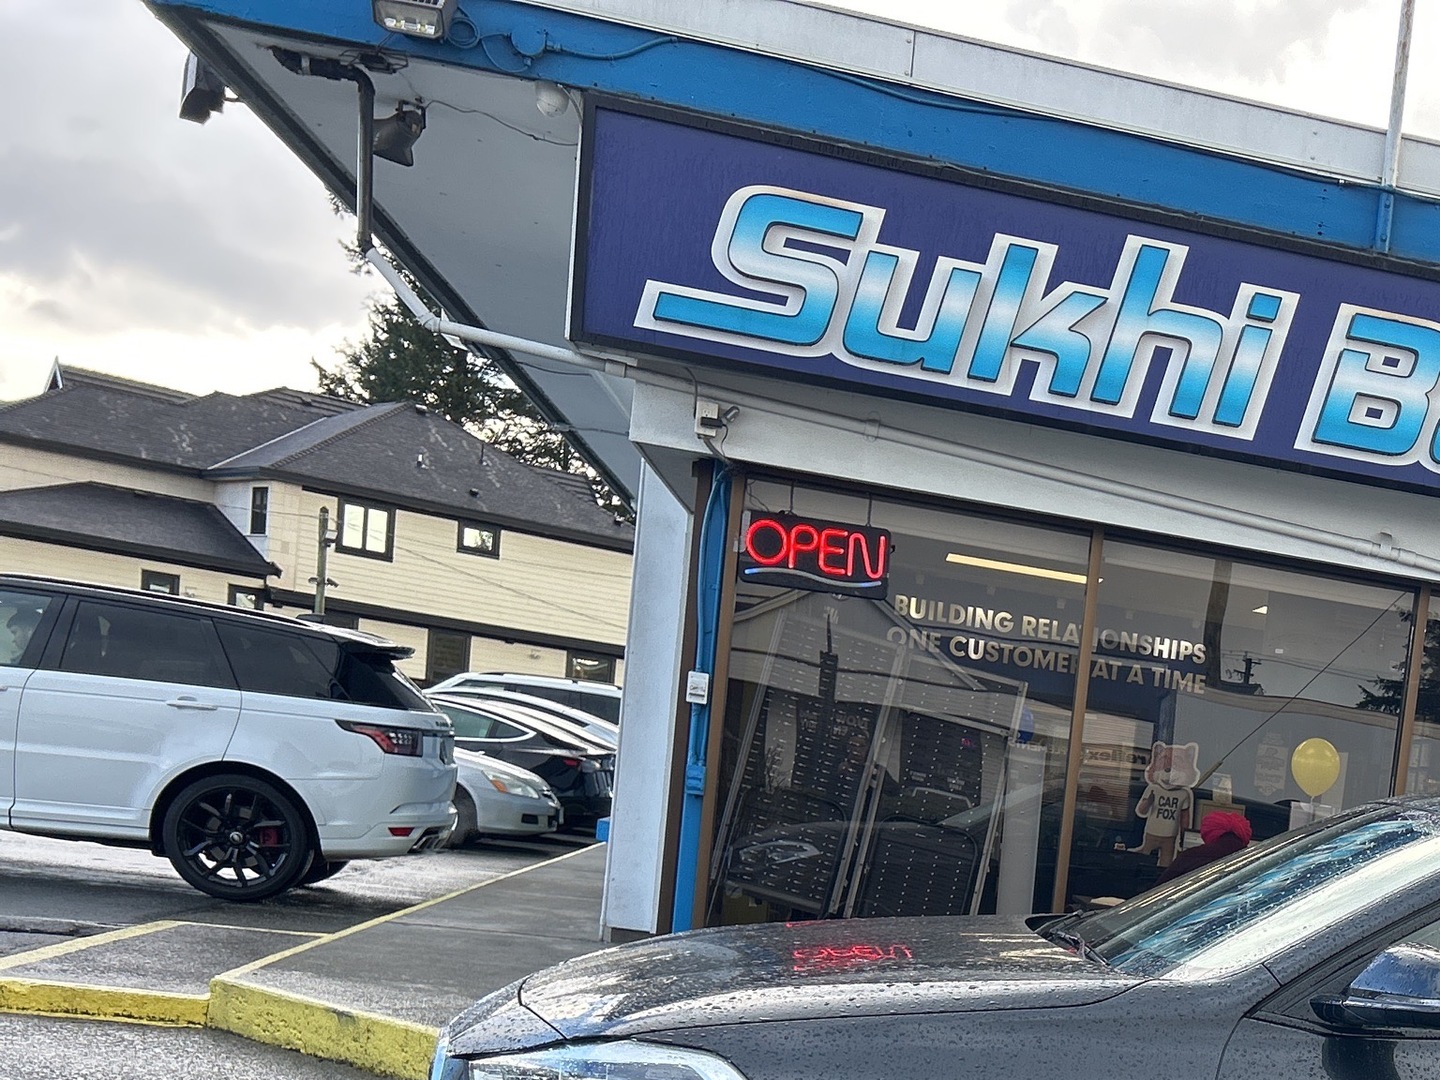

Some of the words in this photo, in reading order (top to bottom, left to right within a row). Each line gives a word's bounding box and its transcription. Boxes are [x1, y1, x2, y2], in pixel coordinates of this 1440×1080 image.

[634, 185, 1299, 441] Sukhi
[745, 518, 887, 579] OPEN
[886, 626, 942, 652] ONE
[1091, 659, 1122, 681] AT
[1126, 664, 1144, 685] A
[1151, 668, 1207, 694] TIME
[894, 594, 1014, 633] BUILDING
[1021, 615, 1207, 664] RELAIONSHIPS
[1156, 808, 1176, 821] FOX
[1158, 795, 1179, 809] CAR
